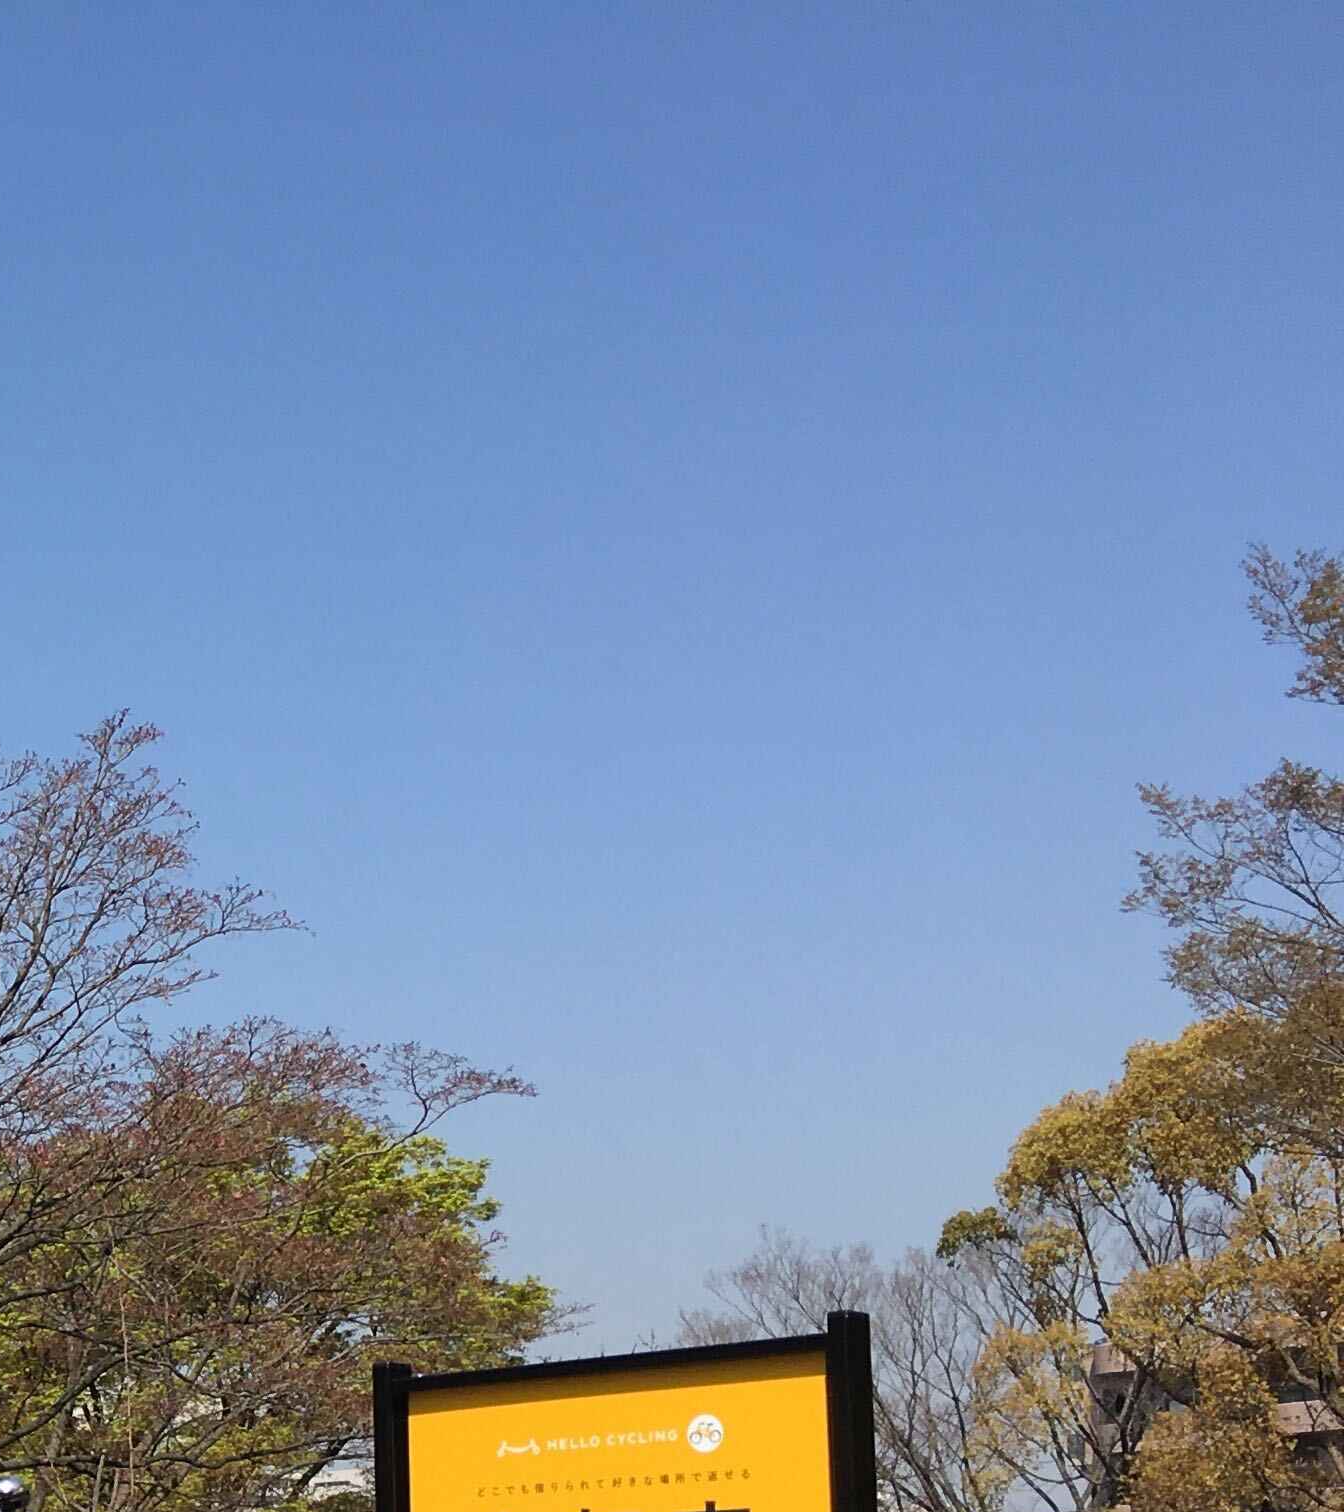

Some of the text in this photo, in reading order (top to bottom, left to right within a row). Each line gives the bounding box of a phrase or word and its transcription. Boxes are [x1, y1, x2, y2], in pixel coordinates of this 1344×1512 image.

[547, 1428, 679, 1451] HELLO CYCLING
[477, 1467, 752, 1498] どこでも借りられて好きな場所で返せる
